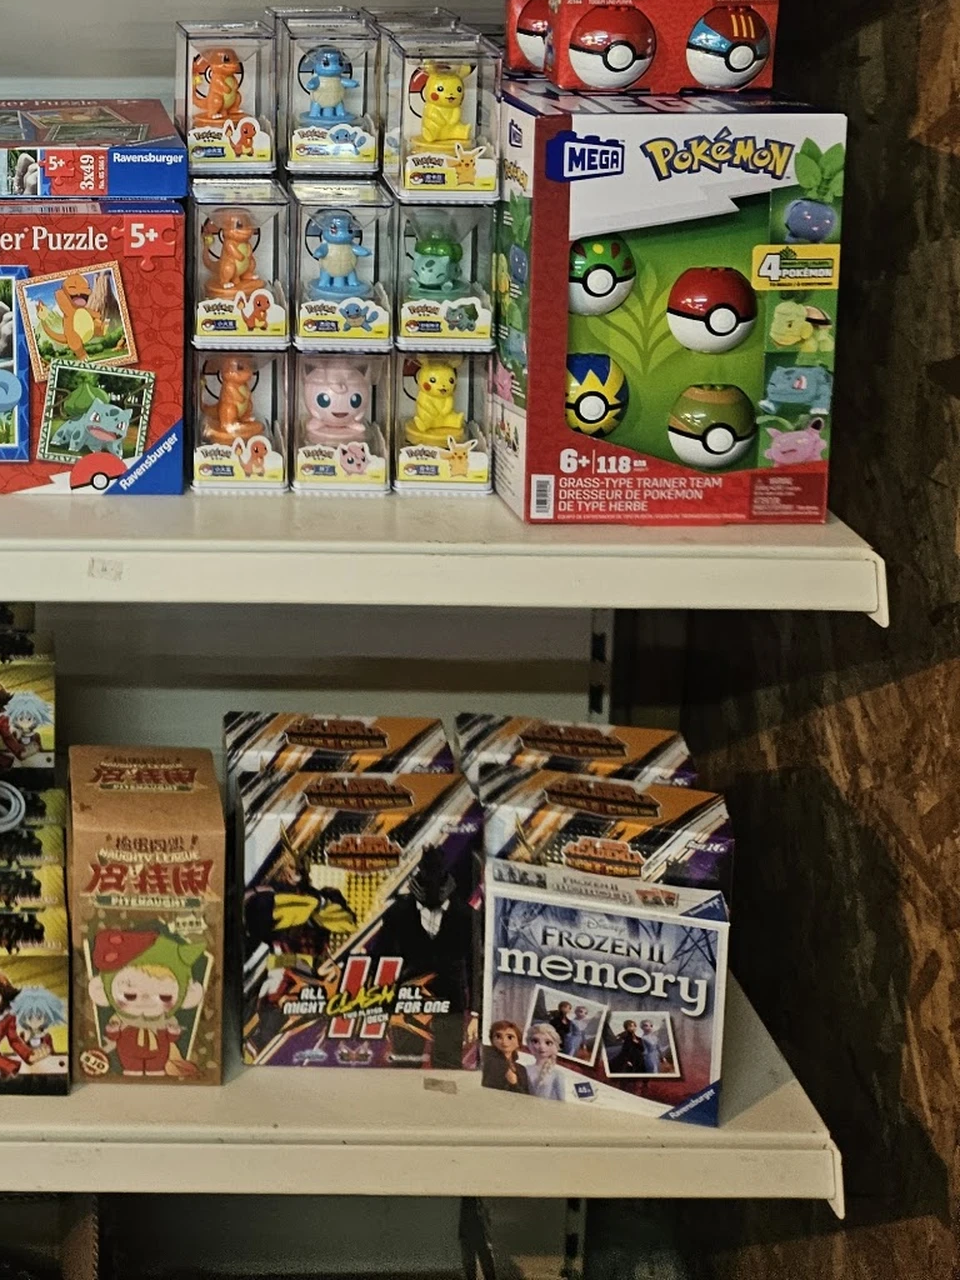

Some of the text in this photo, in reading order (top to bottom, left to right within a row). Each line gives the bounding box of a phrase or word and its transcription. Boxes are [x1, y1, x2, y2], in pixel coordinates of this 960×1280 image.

[48, 156, 66, 171] 5+
[113, 152, 184, 166] Ravensburger
[568, 147, 620, 171] MEGA
[80, 154, 96, 191] 3x49
[31, 226, 109, 251] Puzzle
[129, 223, 159, 248] 5+
[758, 253, 781, 281] 4
[118, 432, 180, 492] Ravensburger
[559, 449, 630, 474] 6+ 118
[559, 477, 723, 488] GRASS-TYPE TRAINER TEAM
[558, 490, 622, 500] DRESSEUR
[625, 490, 642, 500] DE
[558, 501, 648, 512] DE TYPE HERBE
[100, 848, 201, 862] NAUGHTY LEAGUE
[541, 926, 667, 964] FROZEN II
[301, 987, 325, 999] ALL
[398, 987, 422, 999] ALL
[497, 947, 708, 1018] memory
[283, 1001, 326, 1014] MIGHT
[326, 984, 396, 1016] CLASH
[395, 1000, 451, 1013] FOR ONE
[668, 1087, 717, 1121] Ravensburger
